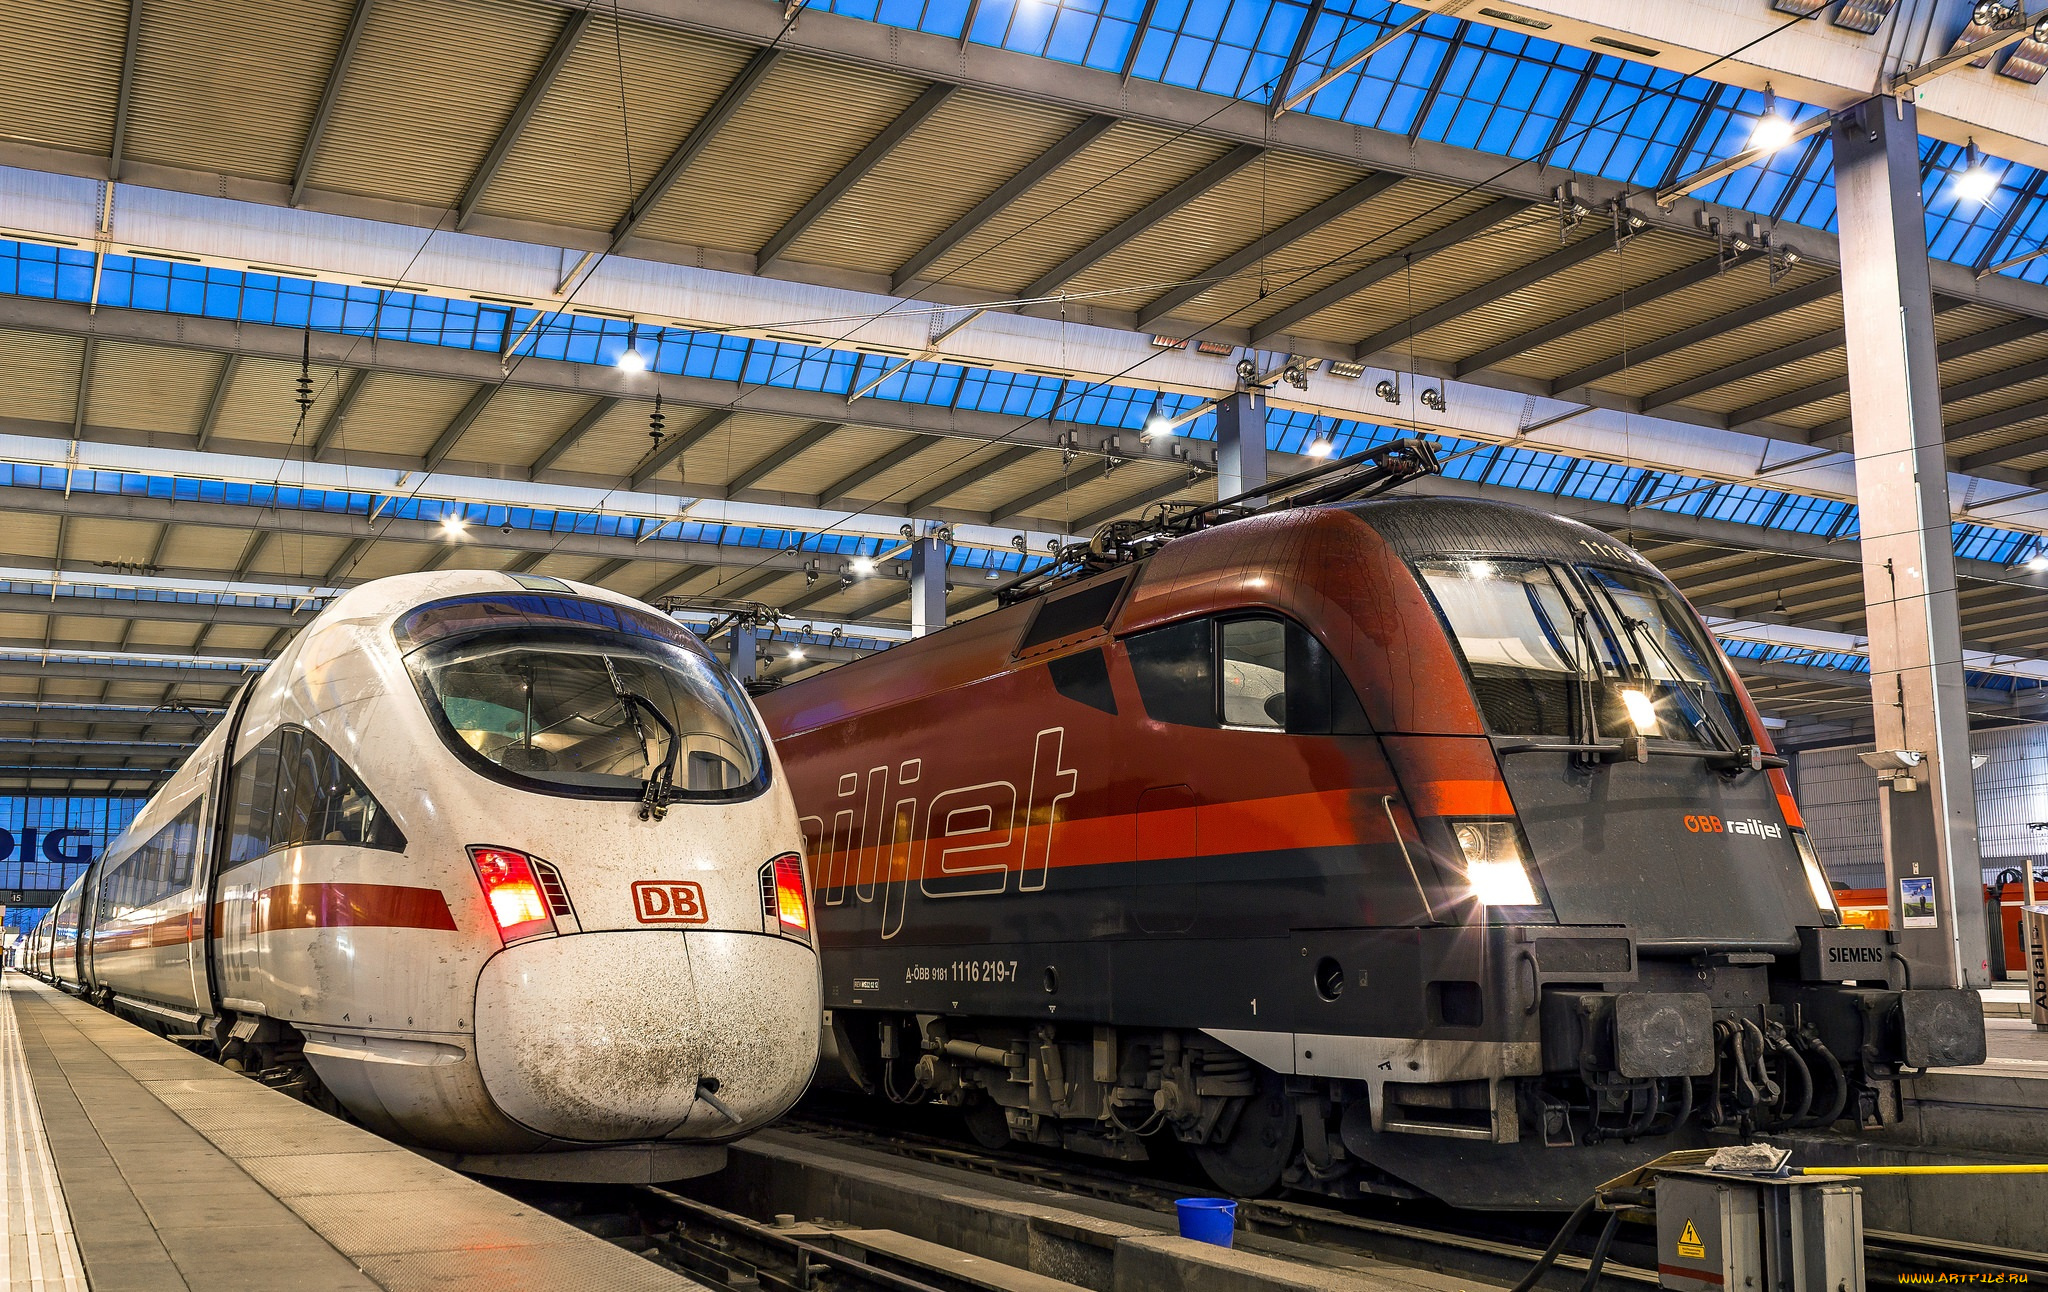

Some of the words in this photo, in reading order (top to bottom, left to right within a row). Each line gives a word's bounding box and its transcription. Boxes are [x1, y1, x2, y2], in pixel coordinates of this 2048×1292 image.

[1579, 539, 1632, 563] 1116
[1683, 813, 1724, 833] ÖBB
[1726, 818, 1782, 840] railjet
[12, 894, 22, 902] 15
[641, 886, 699, 916] DB
[1828, 947, 1883, 963] SIEMENS
[905, 963, 931, 984] A-ÖBB
[931, 967, 949, 981] 9181
[951, 960, 980, 982] 1116
[982, 960, 1018, 982] 219-7
[2030, 944, 2048, 1011] Abfall
[1250, 998, 1257, 1016] 1
